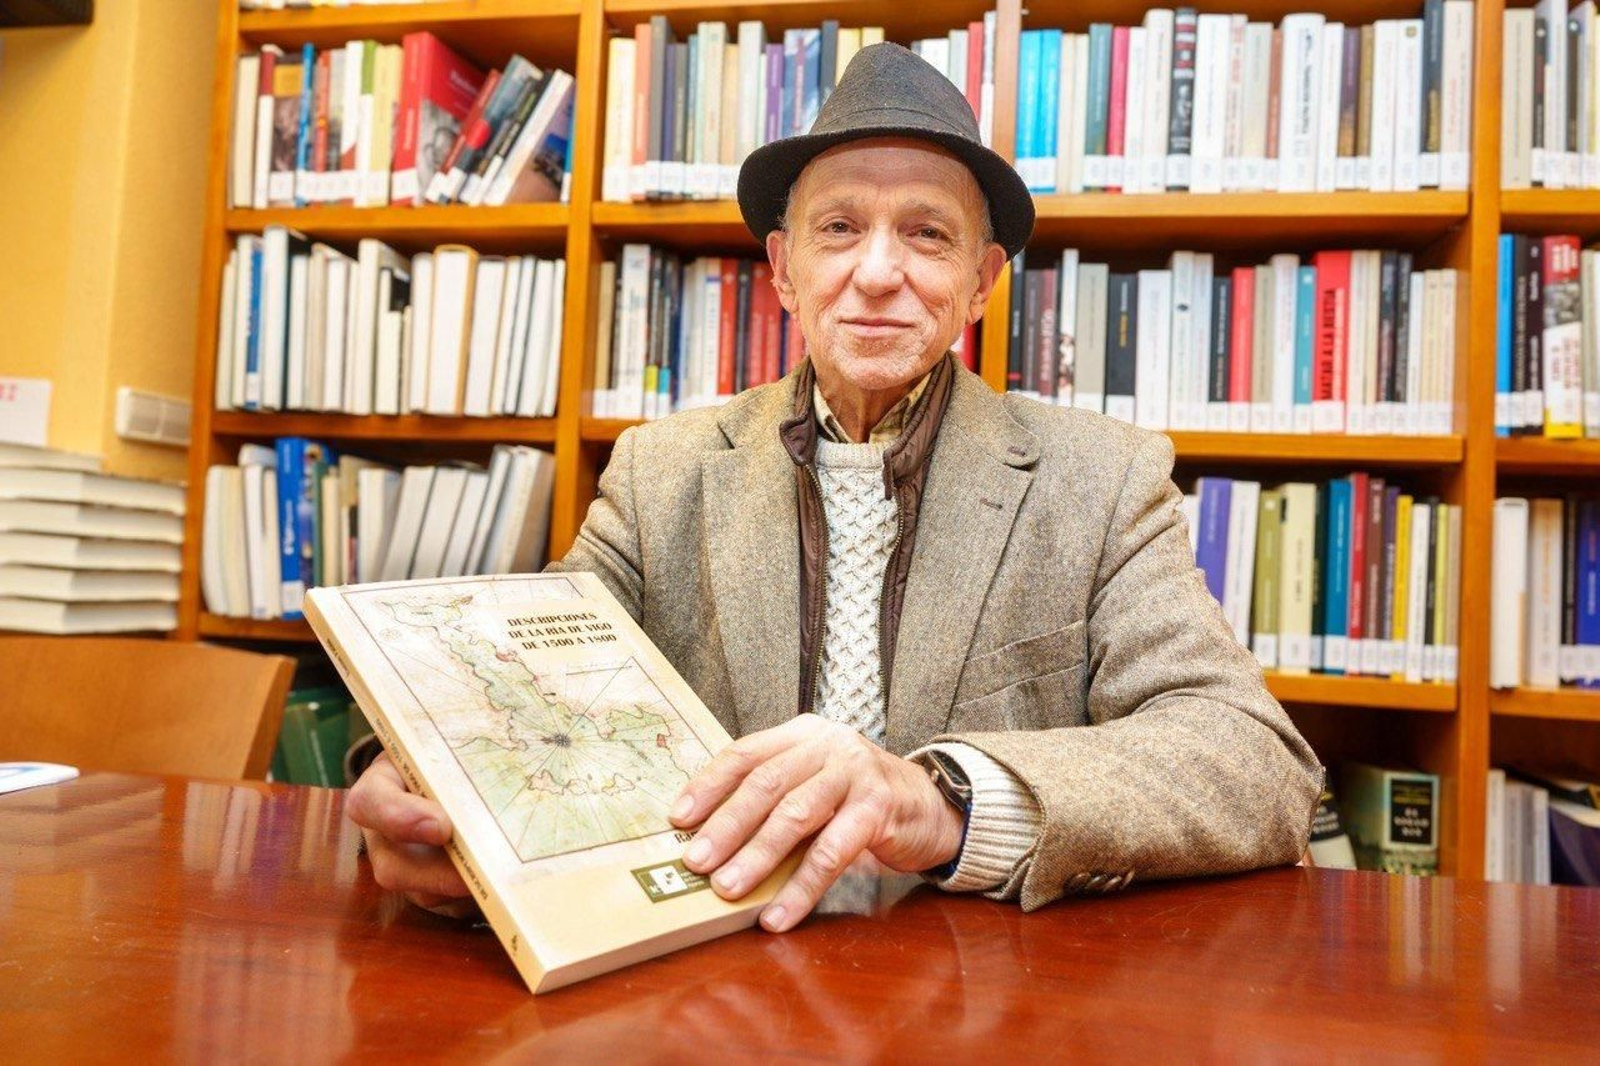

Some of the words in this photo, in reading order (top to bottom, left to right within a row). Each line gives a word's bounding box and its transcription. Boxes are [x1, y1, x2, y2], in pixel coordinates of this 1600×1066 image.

[507, 613, 597, 627] DESCRIPCIONES
[508, 630, 526, 639] DE
[527, 628, 545, 638] LA
[567, 625, 585, 633] DE
[586, 622, 613, 632] VIGO
[521, 641, 541, 650] DE
[542, 637, 575, 647] 1500
[576, 636, 586, 645] A
[586, 634, 617, 644] 1800
